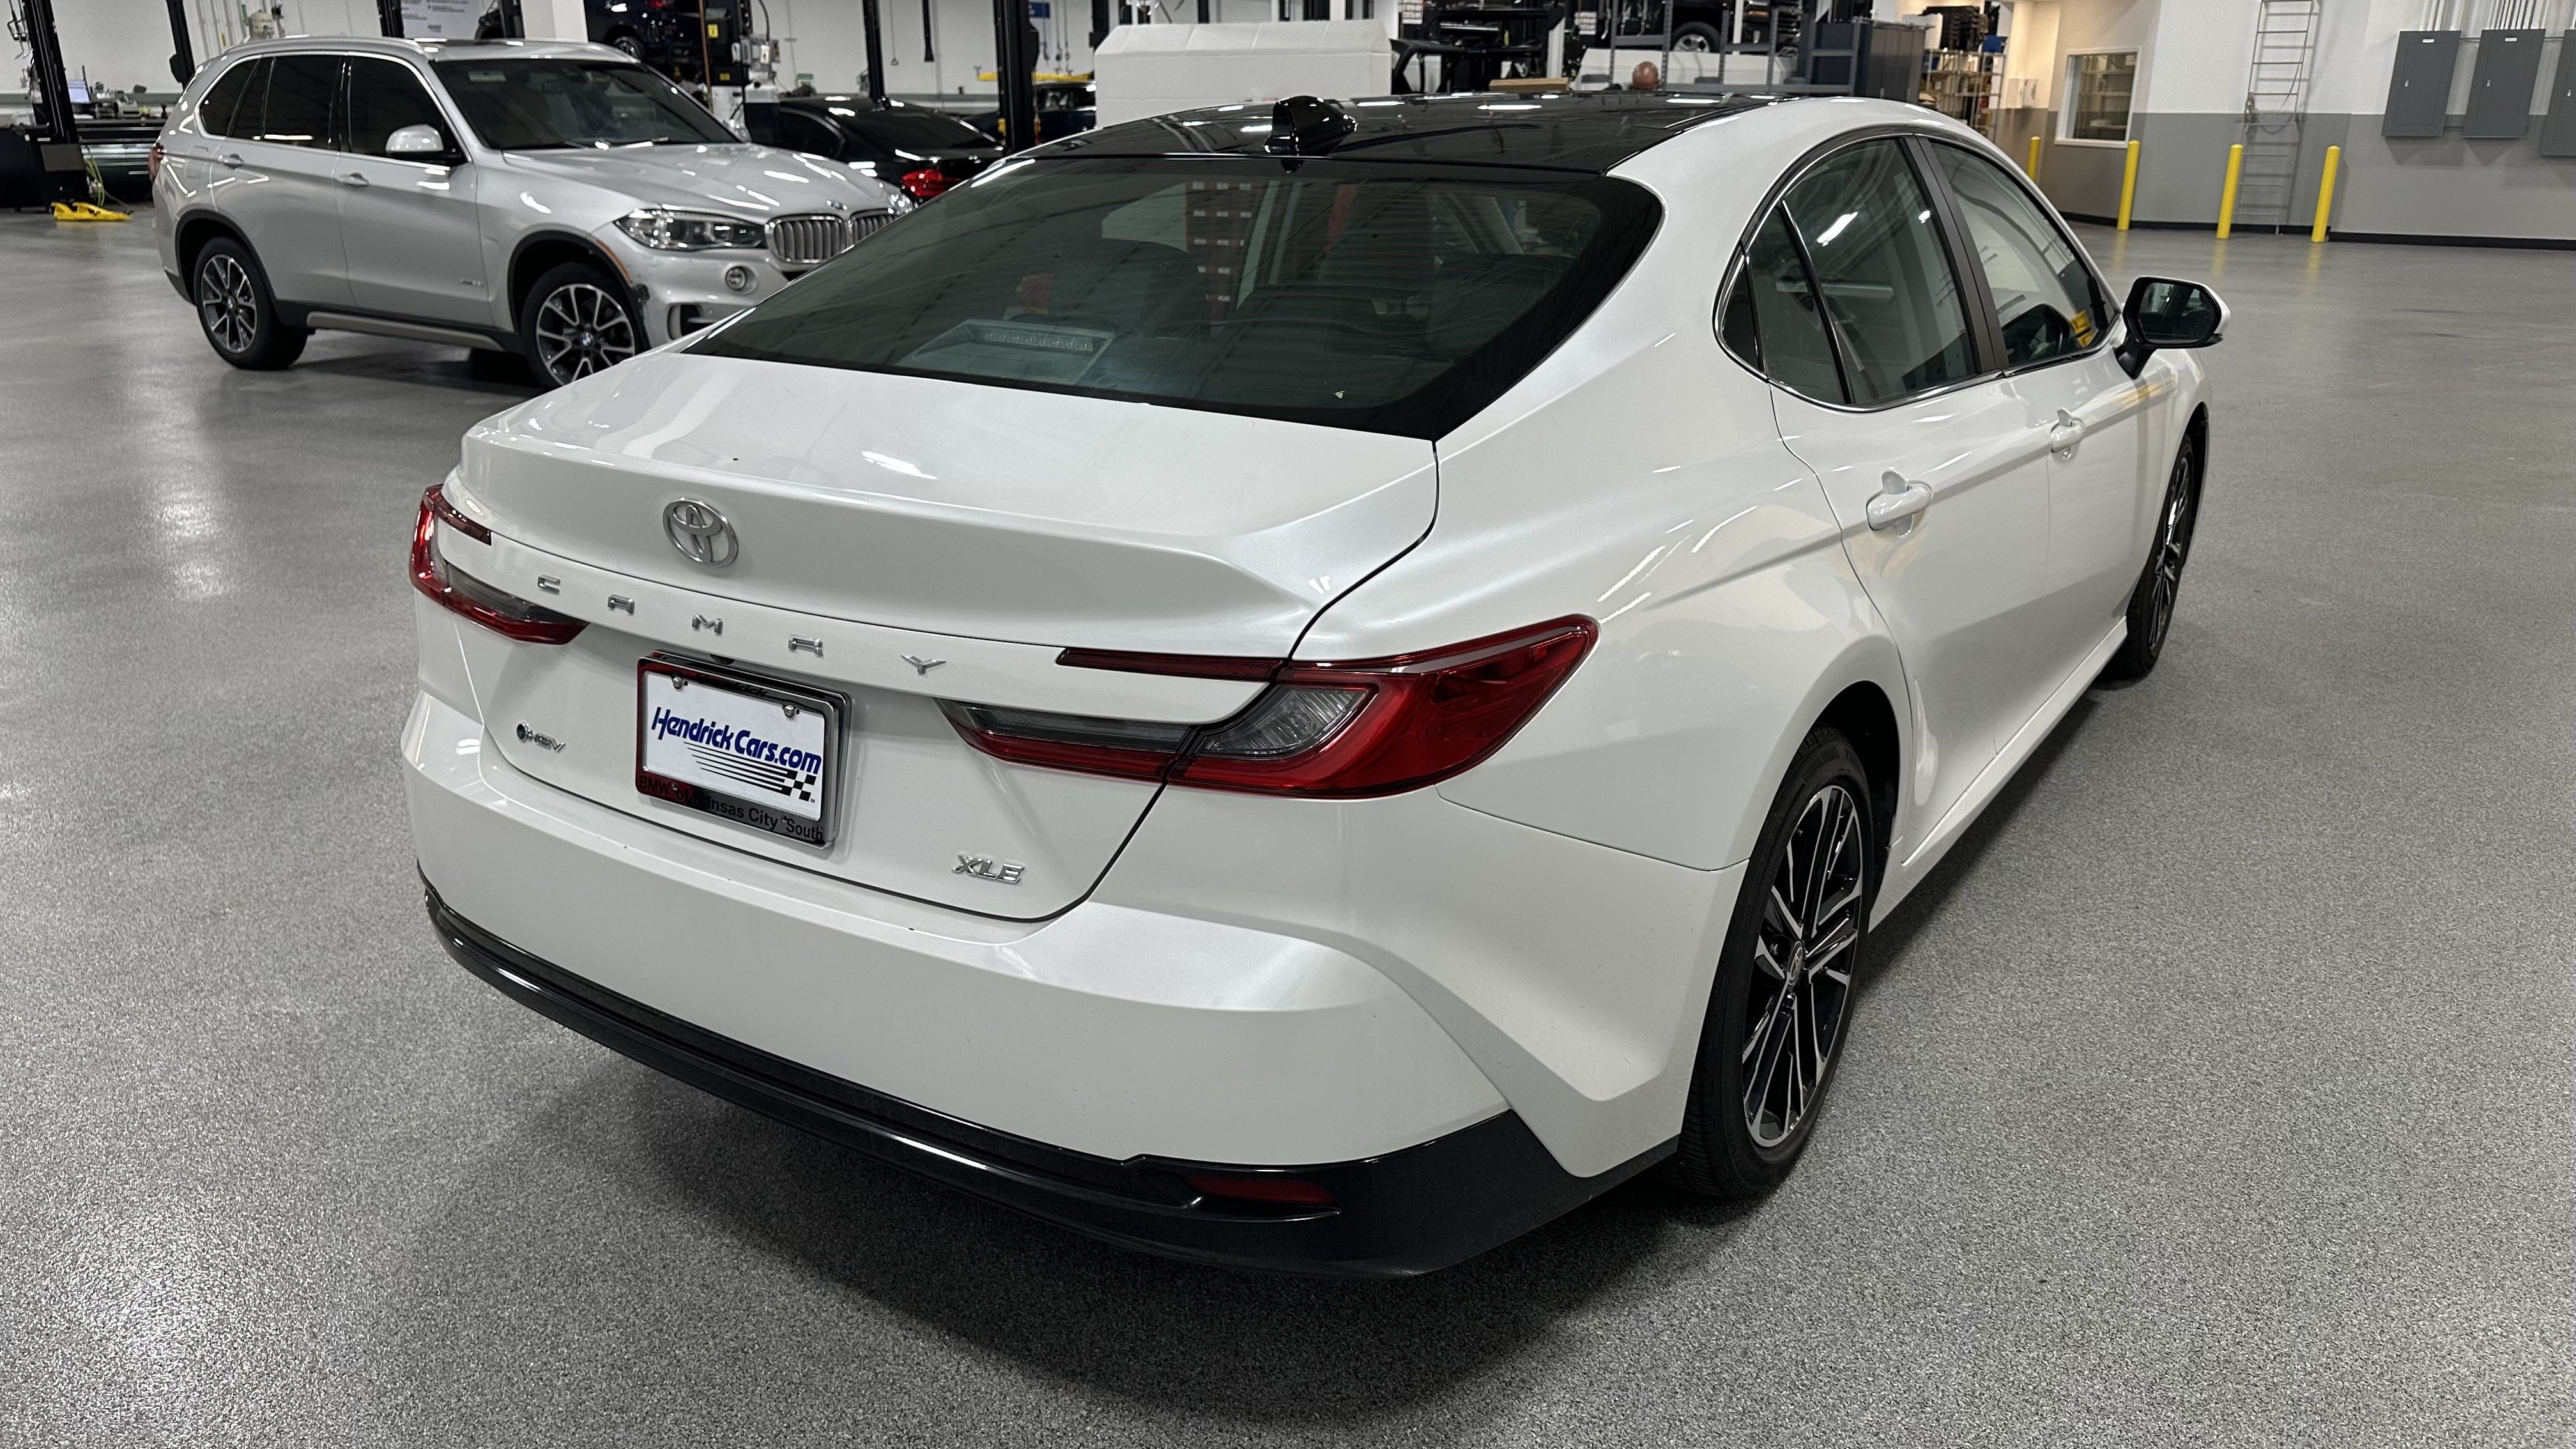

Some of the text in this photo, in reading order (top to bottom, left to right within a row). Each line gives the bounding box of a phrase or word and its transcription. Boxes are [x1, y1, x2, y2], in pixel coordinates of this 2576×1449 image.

[537, 575, 947, 675] CAMRY
[640, 776, 669, 795] BMW
[748, 808, 778, 831] City
[786, 818, 824, 841] South
[951, 855, 1025, 883] XLE
